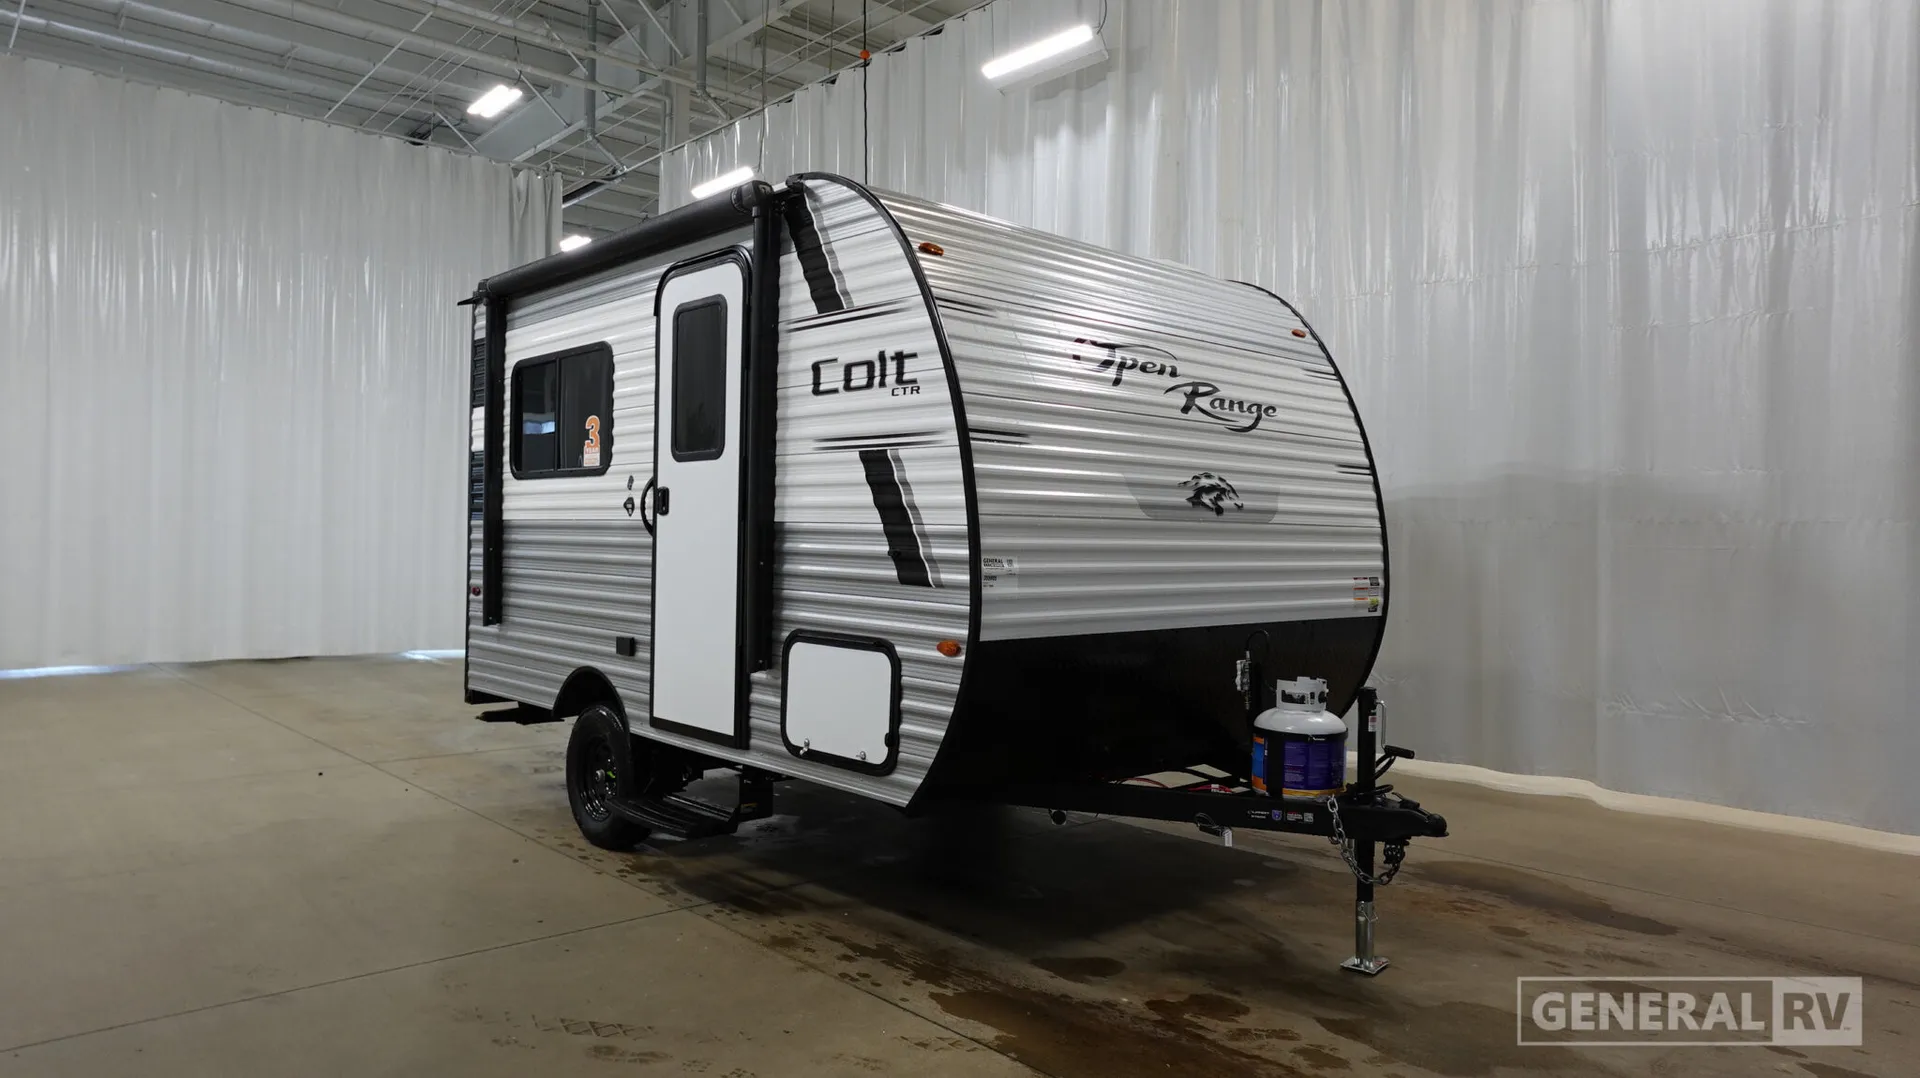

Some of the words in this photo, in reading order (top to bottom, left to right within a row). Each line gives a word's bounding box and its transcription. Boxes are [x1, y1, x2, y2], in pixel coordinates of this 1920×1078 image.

[811, 349, 918, 396] Colt
[891, 385, 921, 397] CTR
[1163, 381, 1278, 432] Range
[585, 415, 600, 449] 3
